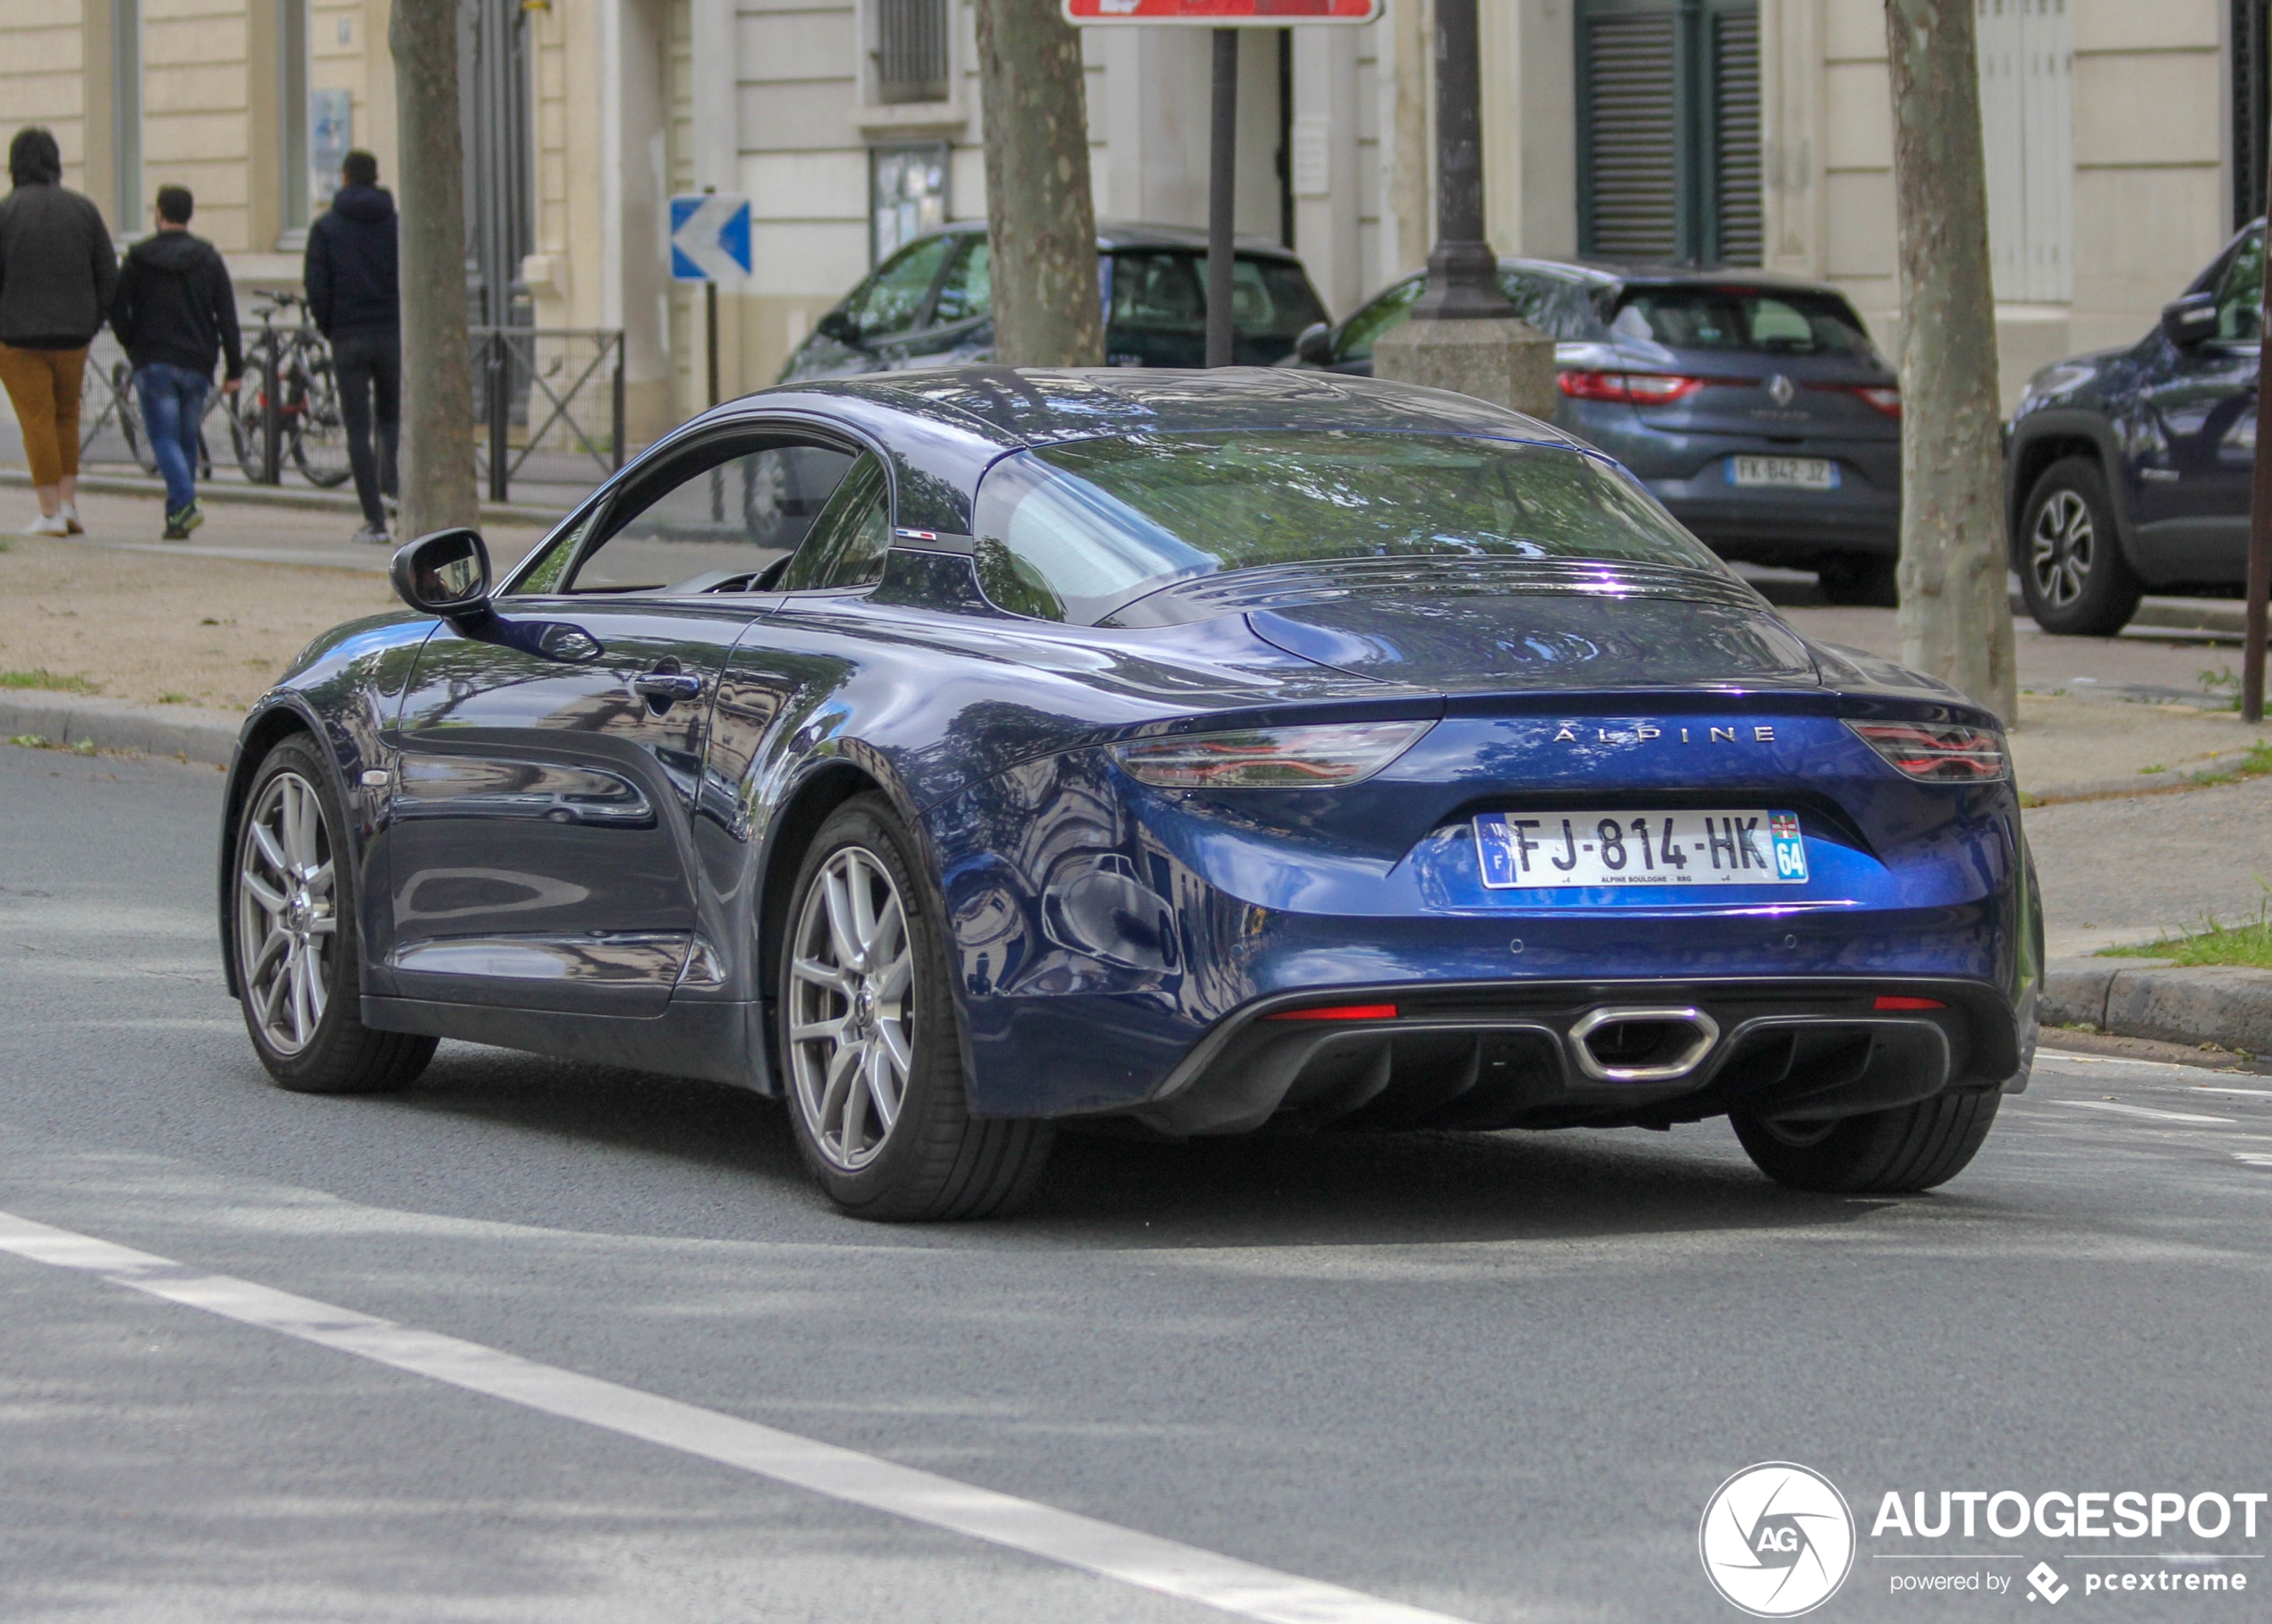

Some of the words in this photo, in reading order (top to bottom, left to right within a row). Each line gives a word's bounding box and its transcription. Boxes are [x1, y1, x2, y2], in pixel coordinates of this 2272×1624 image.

[1553, 727, 1776, 743] ALPINE
[1513, 817, 1768, 872] FJ-814-HK
[1493, 855, 1503, 870] F
[1776, 842, 1805, 876] 64
[1676, 875, 1692, 883] RRG
